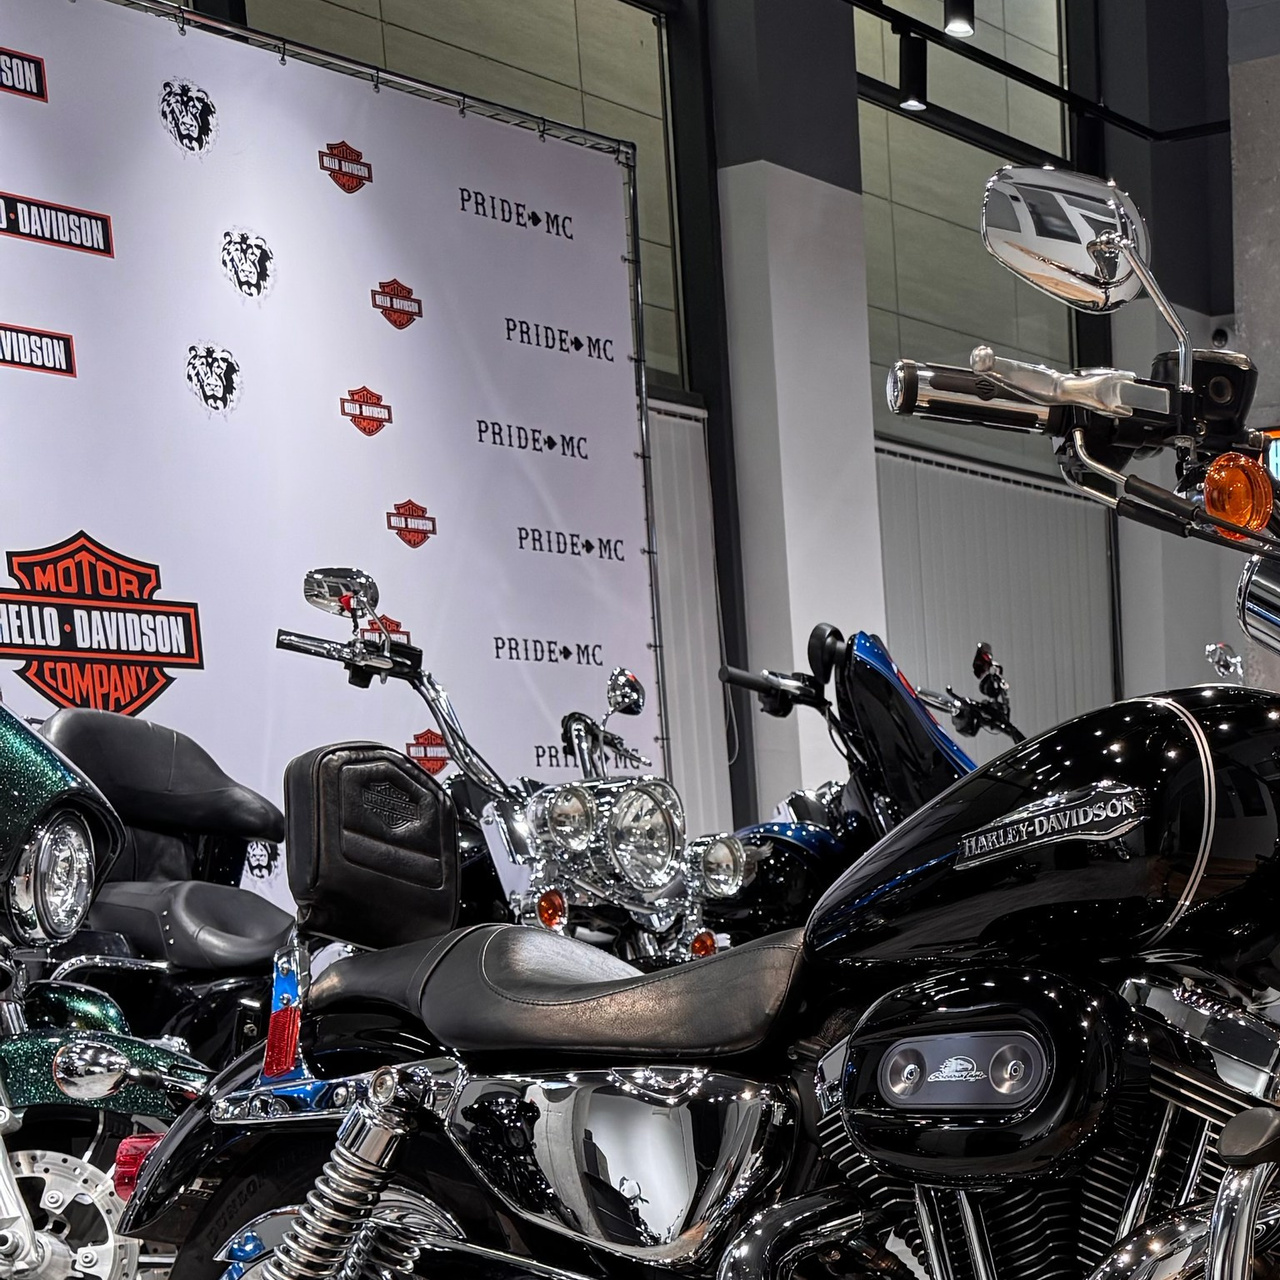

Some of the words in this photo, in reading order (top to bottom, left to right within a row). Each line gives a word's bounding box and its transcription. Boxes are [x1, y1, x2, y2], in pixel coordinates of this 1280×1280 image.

[17, 202, 105, 250] DAVIDSON
[459, 187, 527, 229] PRIDE
[545, 211, 573, 240] MC
[505, 317, 570, 354] PRIDE
[586, 336, 614, 362] MC
[477, 420, 543, 452] PRIDE
[560, 434, 588, 460] MC
[517, 527, 581, 556] PRIDE
[597, 538, 625, 562] MC
[34, 550, 140, 599] MOTOR
[73, 609, 187, 654] DAVIDSON
[493, 637, 559, 663] PRIDE
[576, 643, 603, 666] MC
[43, 662, 149, 711] COMPANY
[962, 797, 1137, 858] HARLEY-DAVIDSON
